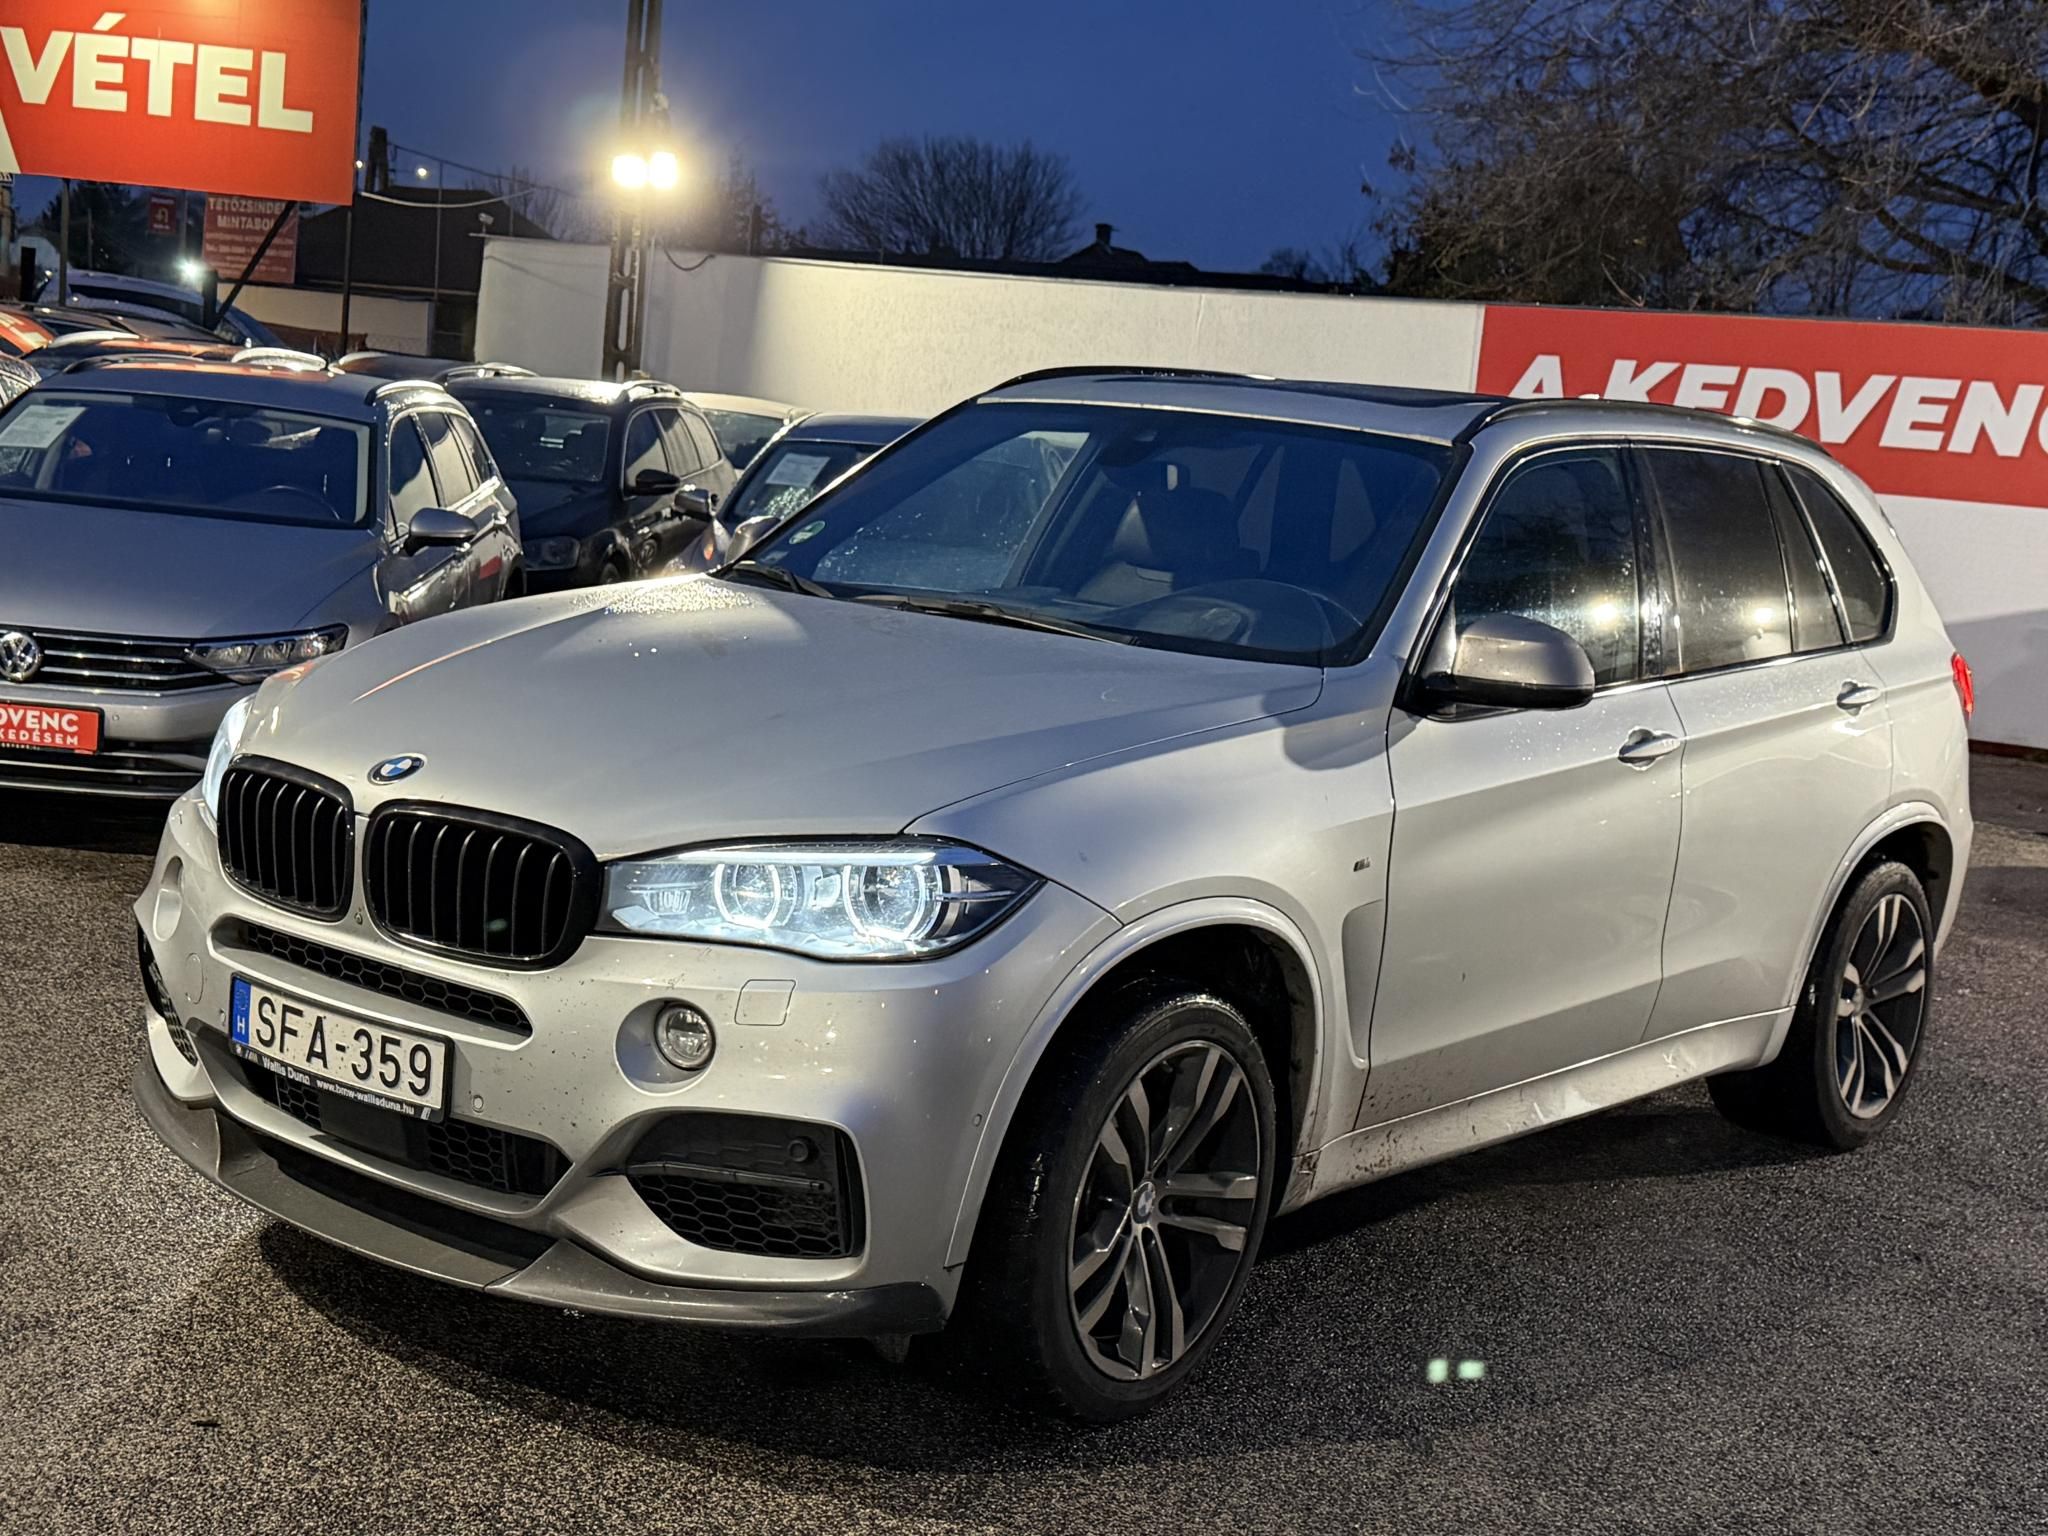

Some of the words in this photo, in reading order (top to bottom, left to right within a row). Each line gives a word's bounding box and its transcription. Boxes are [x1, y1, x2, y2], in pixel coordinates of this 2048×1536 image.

[0, 12, 313, 133] VÉTEL
[236, 1015, 246, 1036] H
[256, 996, 431, 1096] SFA-359
[261, 1055, 286, 1077] Wallis
[287, 1066, 311, 1086] Duna
